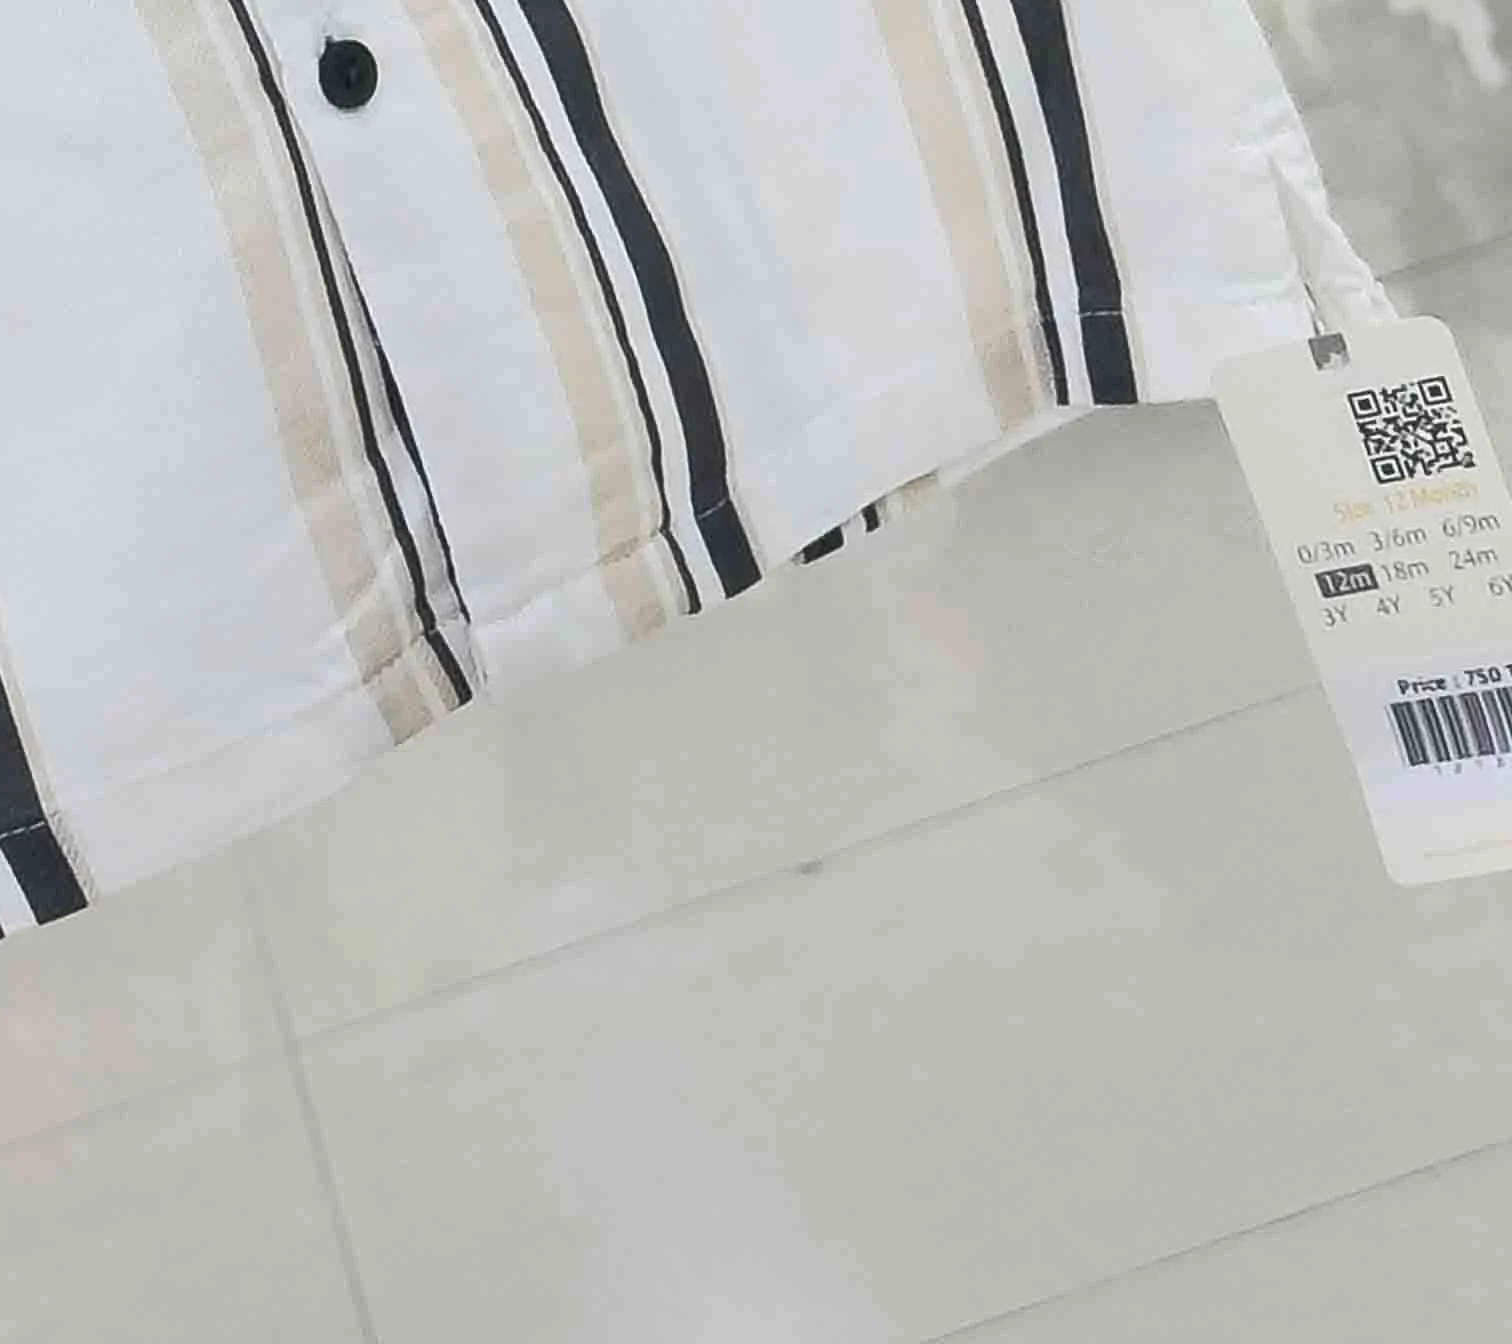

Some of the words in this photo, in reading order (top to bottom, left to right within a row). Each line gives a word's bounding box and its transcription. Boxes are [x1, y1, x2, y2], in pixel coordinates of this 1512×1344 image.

[1297, 540, 1356, 564] 0/3m
[1369, 527, 1428, 552] 3/6m
[1442, 514, 1502, 538] 6/9m
[1321, 569, 1374, 595] 12m
[1381, 560, 1430, 582] 18m
[1448, 548, 1498, 570] 24m
[1322, 604, 1349, 627] 3Y
[1376, 595, 1402, 616] 4Y
[1428, 585, 1455, 607] 5Y
[1463, 666, 1502, 686] 750
